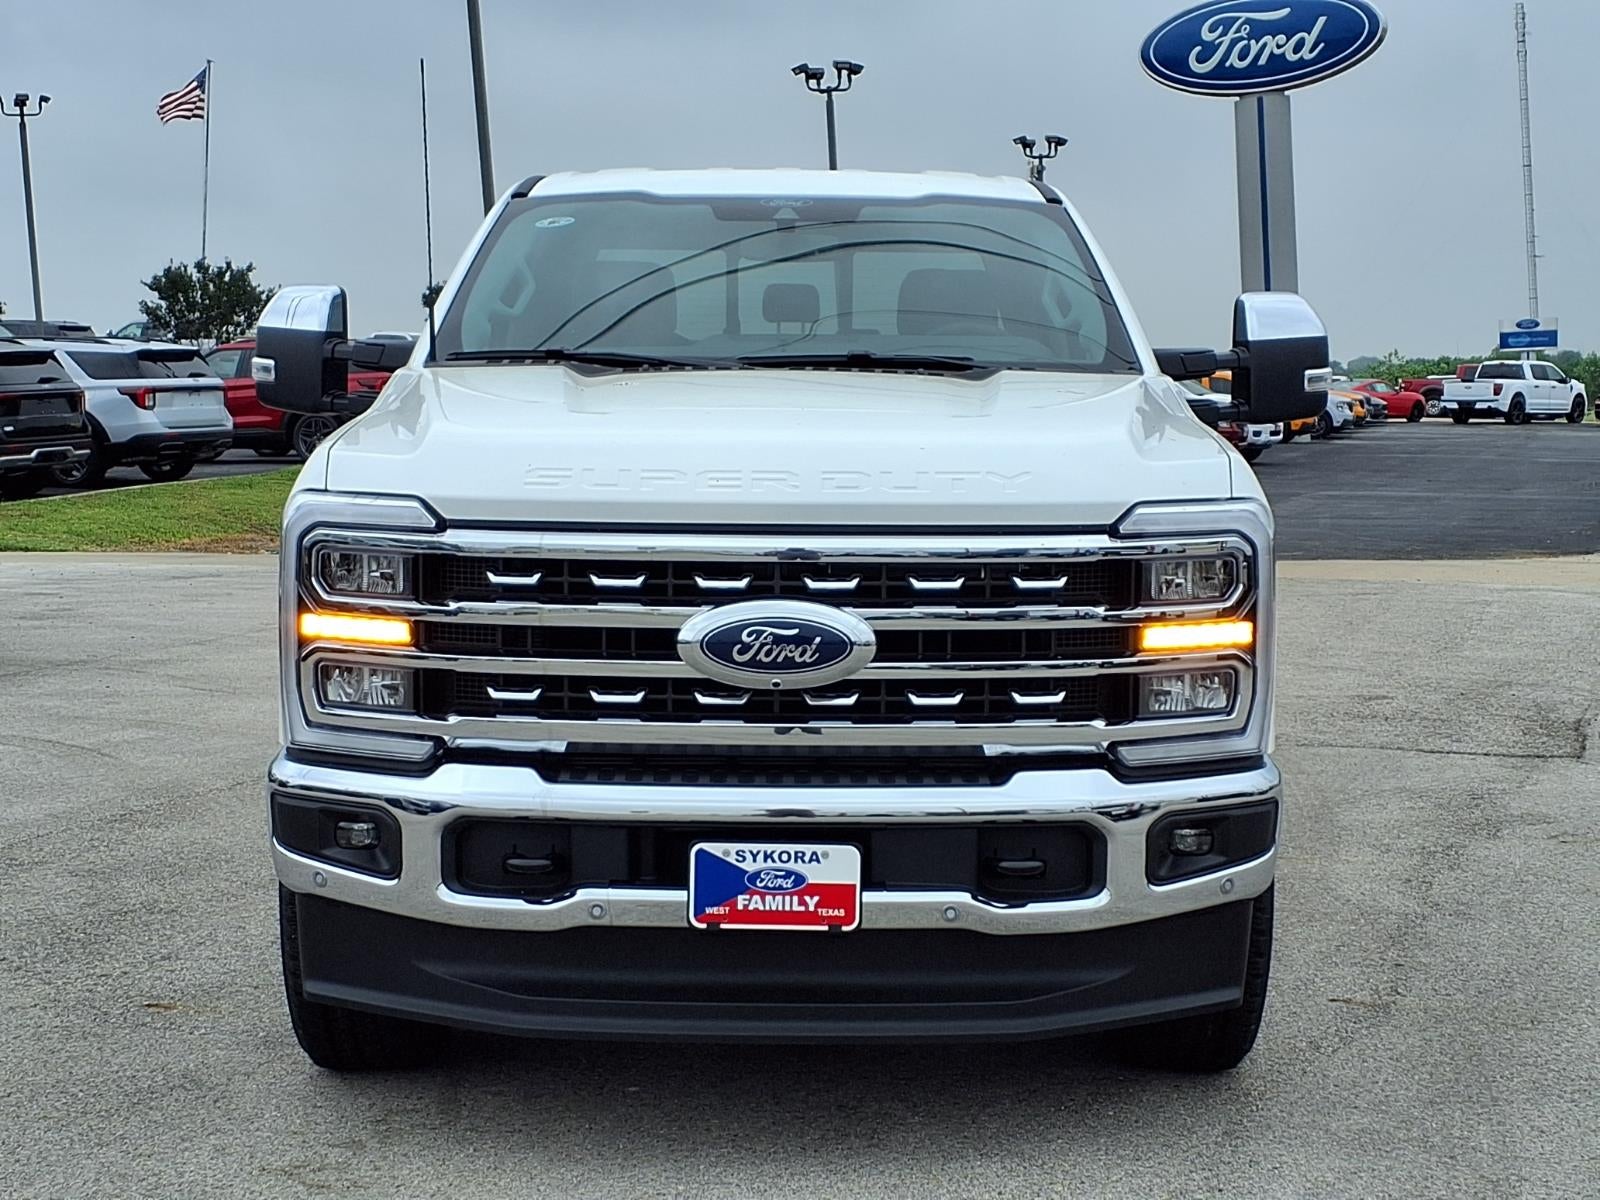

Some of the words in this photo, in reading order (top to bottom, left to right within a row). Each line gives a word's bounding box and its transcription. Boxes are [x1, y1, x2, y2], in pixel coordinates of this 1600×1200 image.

[1188, 7, 1328, 74] Ford
[523, 467, 801, 493] SUPER
[820, 470, 1033, 494] DUTY
[732, 625, 822, 663] Ford
[734, 849, 822, 865] SYKORA
[755, 869, 796, 889] Ford
[705, 906, 730, 915] WEST
[737, 894, 821, 912] FAMILY
[817, 907, 846, 917] TEXAS
